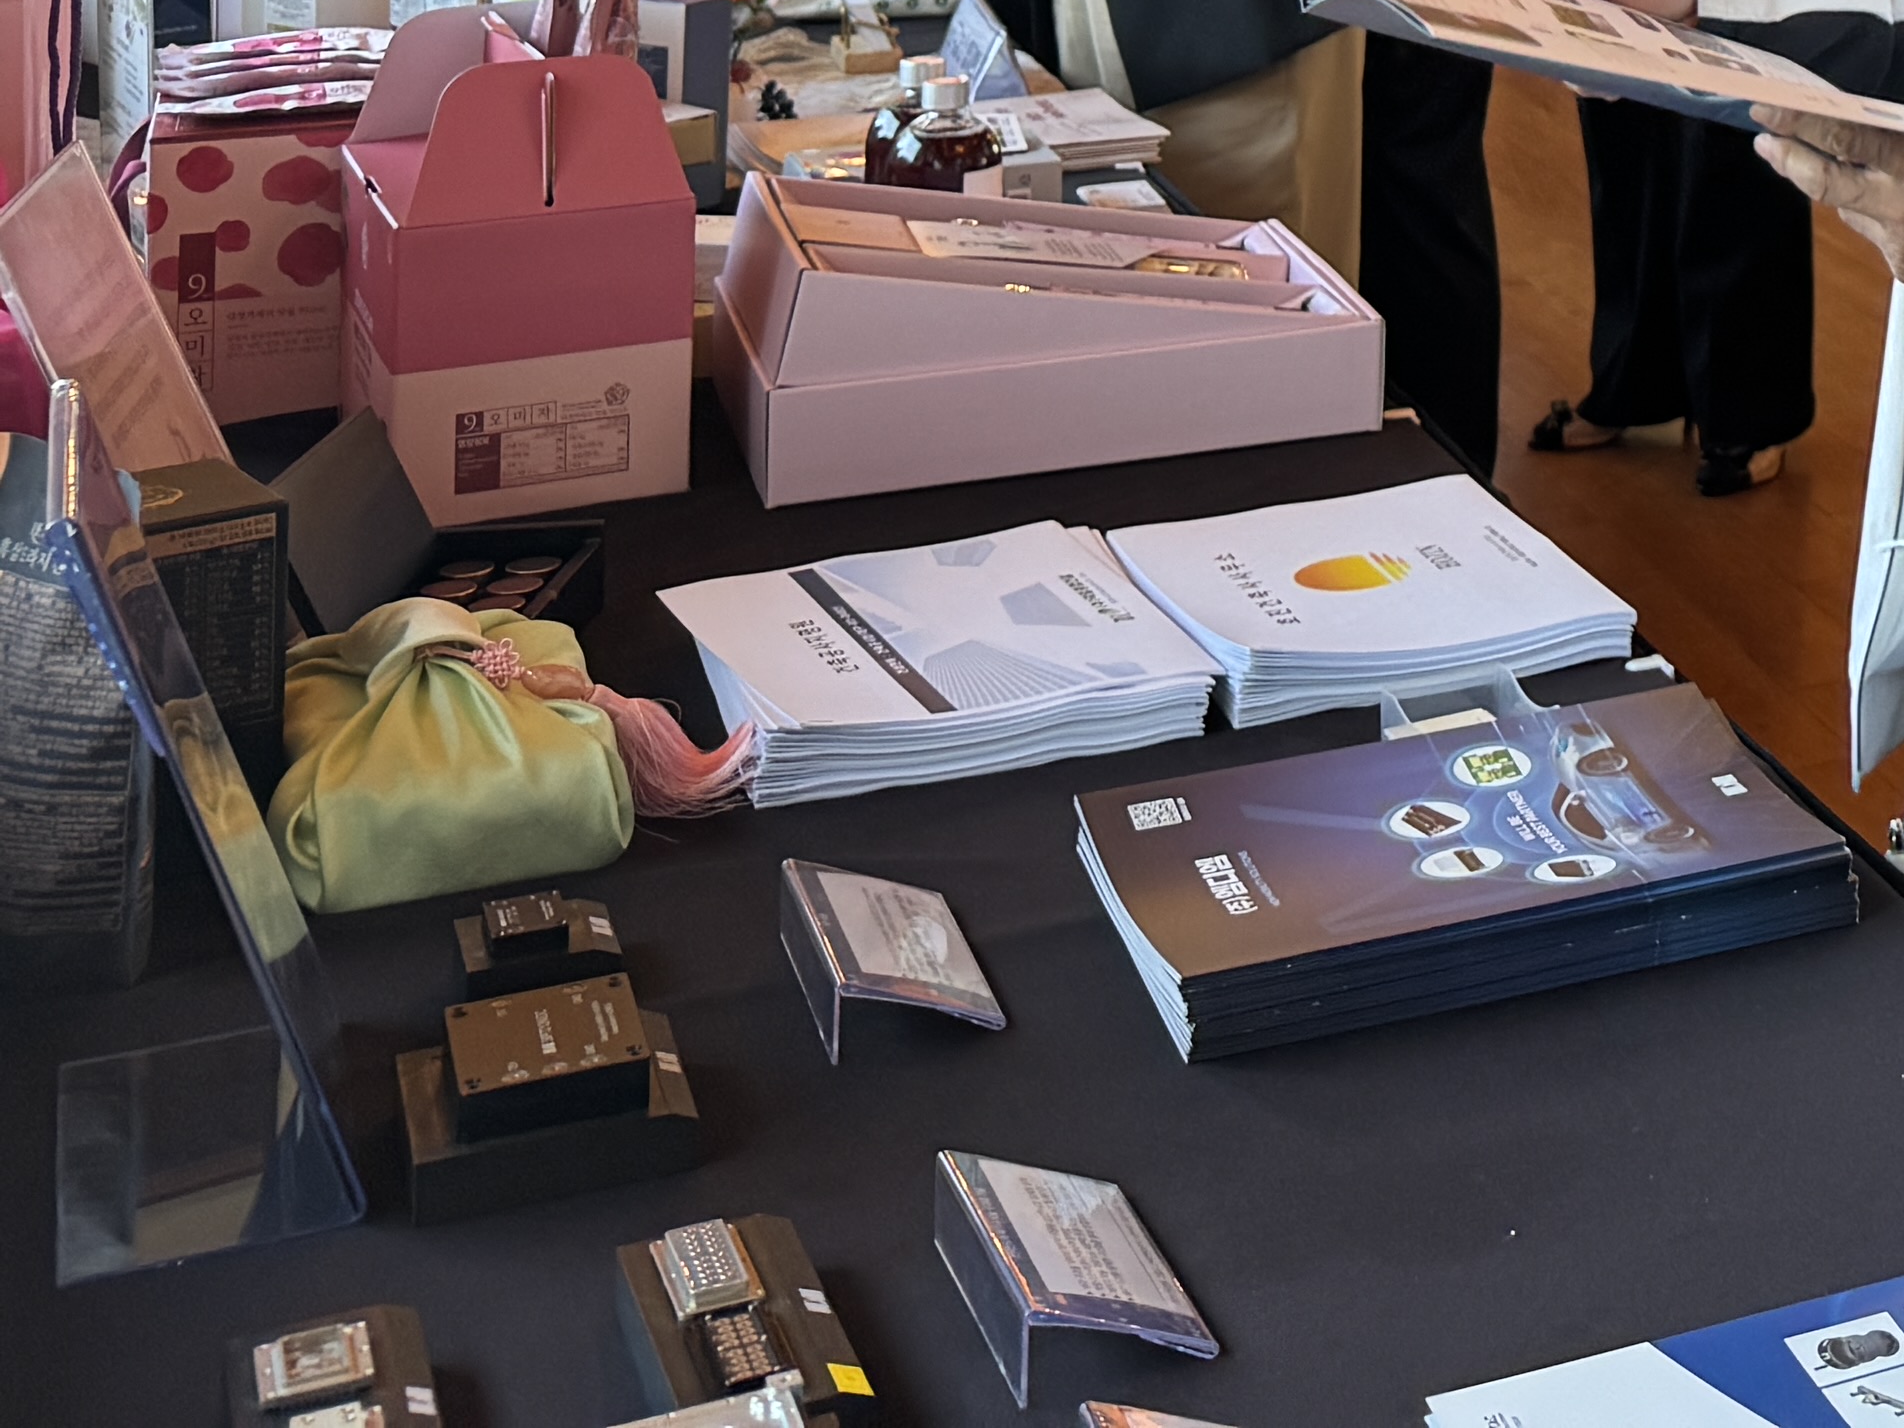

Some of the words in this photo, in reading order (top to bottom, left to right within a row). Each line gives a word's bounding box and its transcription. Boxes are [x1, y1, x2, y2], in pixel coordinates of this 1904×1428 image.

[188, 273, 207, 299] 9
[464, 413, 477, 432] 9
[1194, 854, 1258, 915] (주)엠디엠
